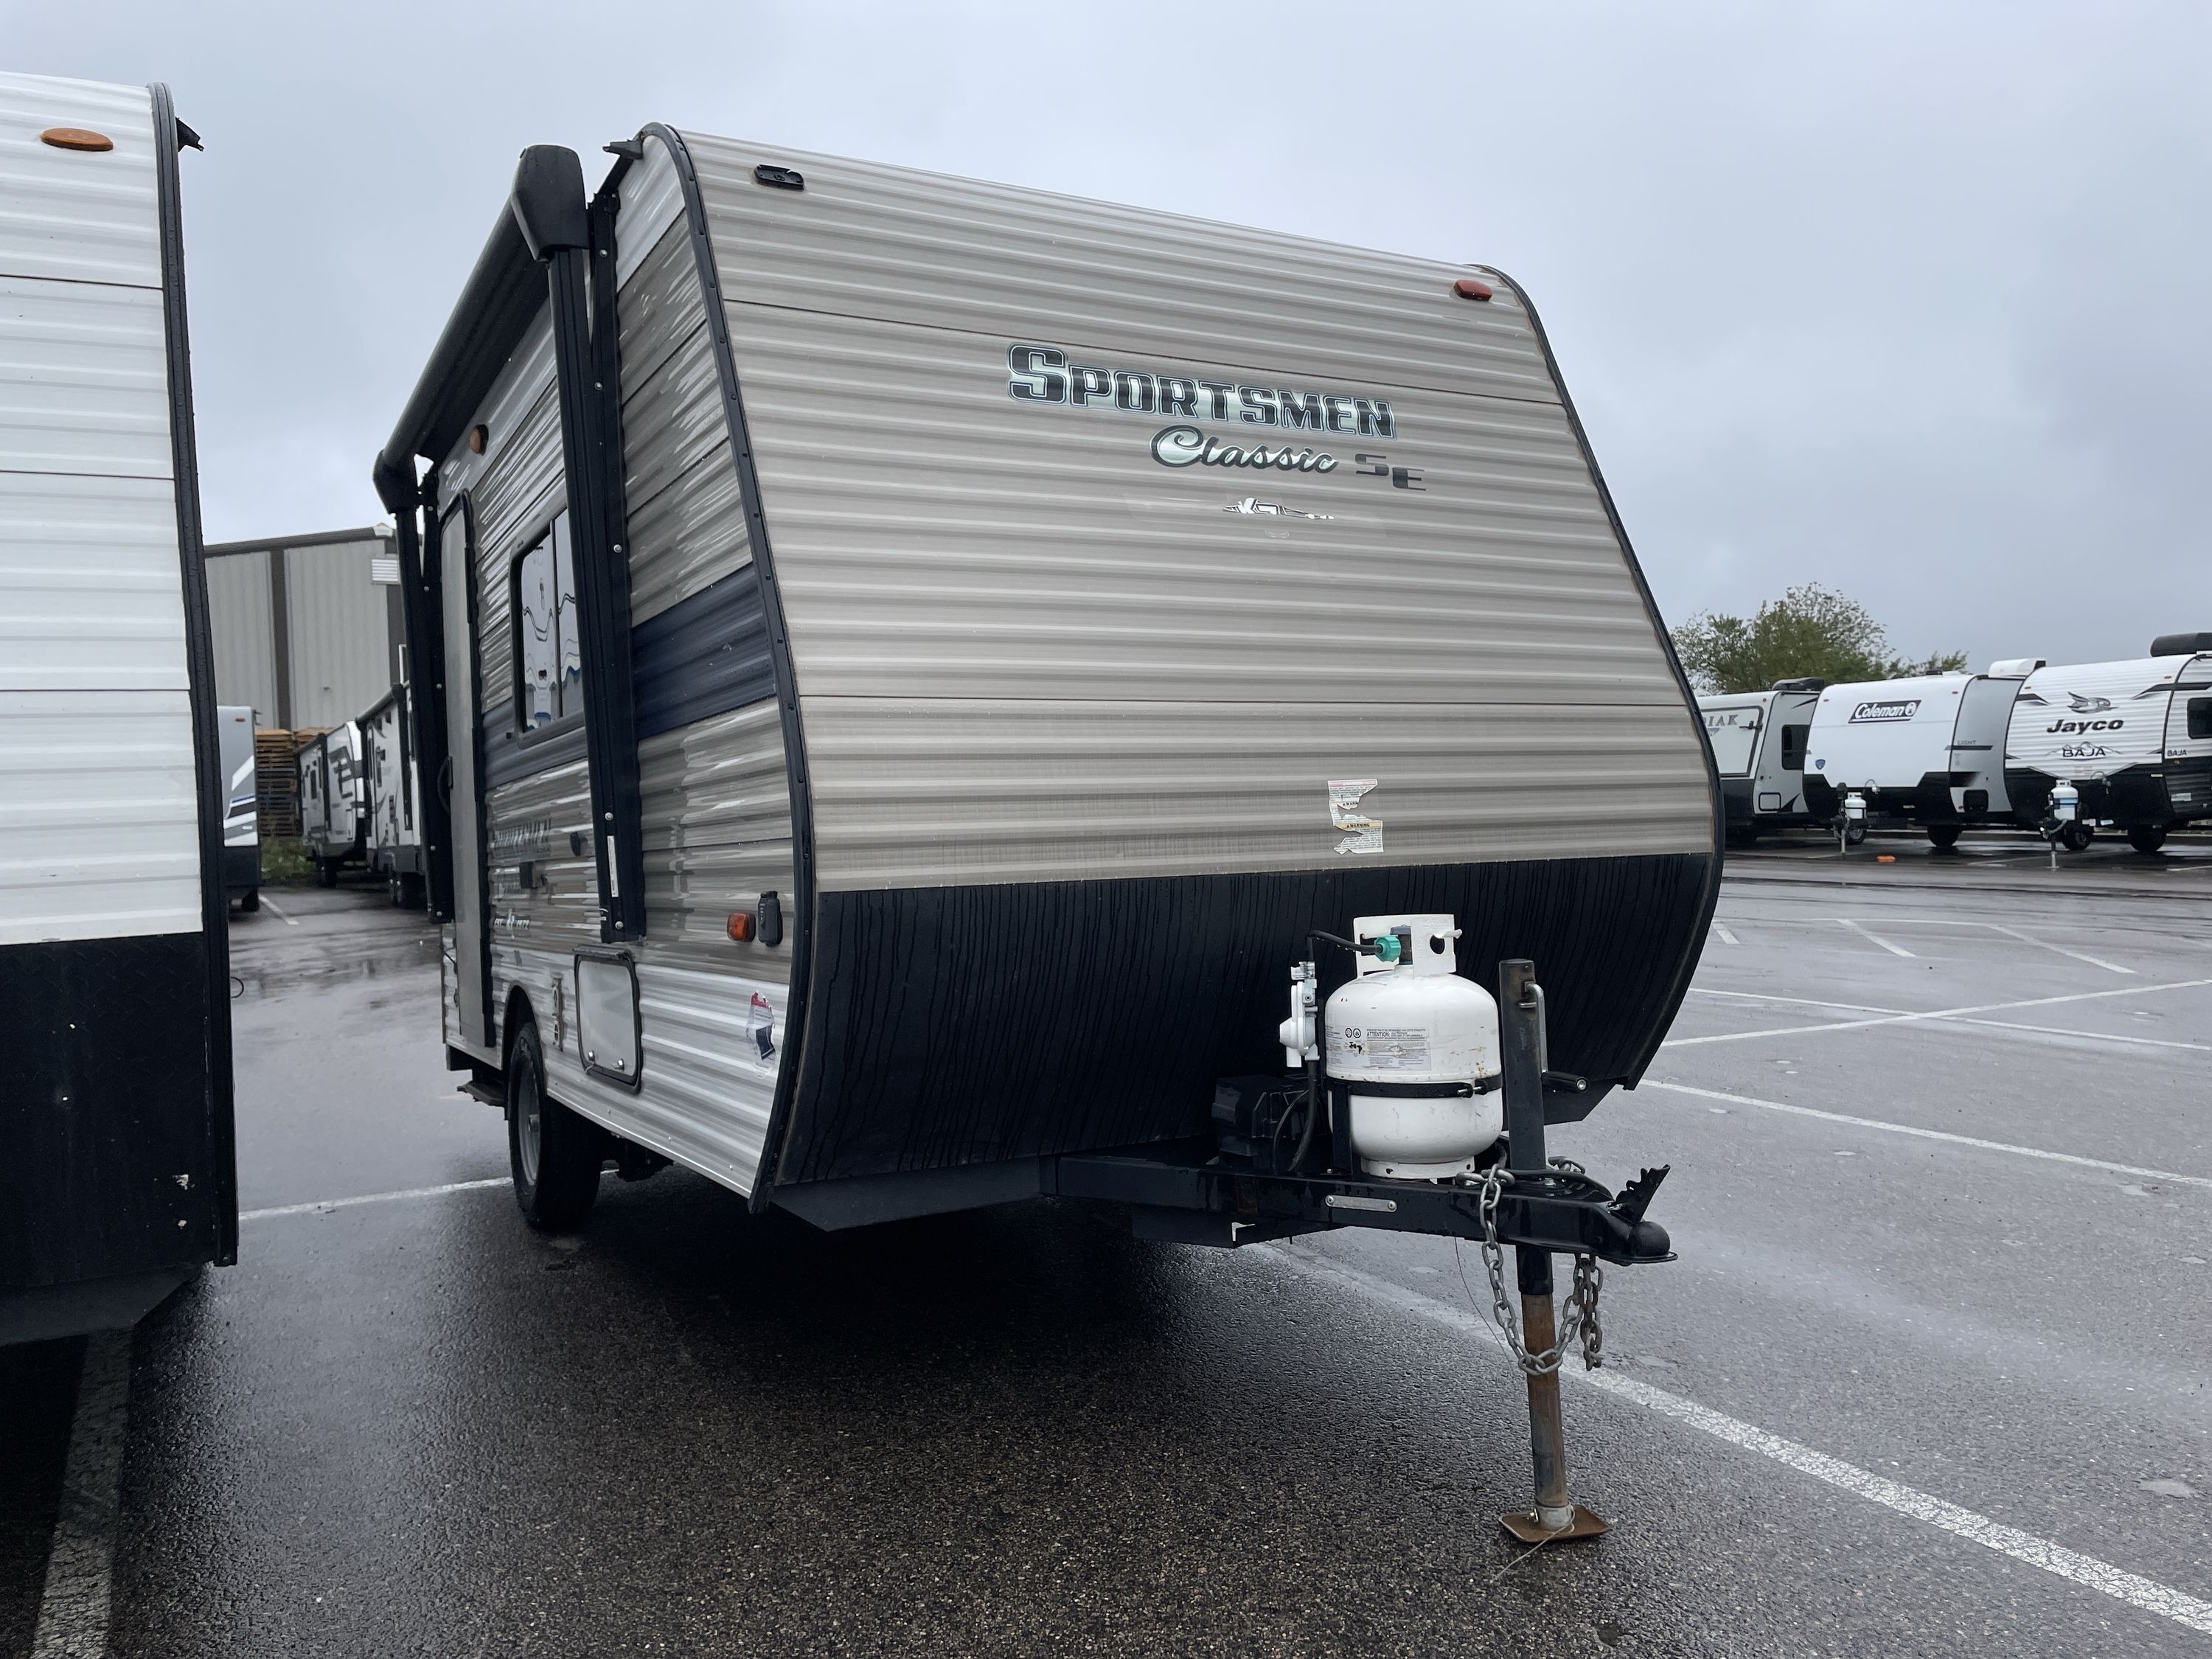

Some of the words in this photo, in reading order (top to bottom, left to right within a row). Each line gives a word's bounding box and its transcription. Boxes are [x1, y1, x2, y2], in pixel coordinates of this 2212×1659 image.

[1006, 342, 1397, 439] SPORTSMEN
[1150, 424, 1339, 473] Classic
[1354, 453, 1427, 491] SE
[1854, 703, 1905, 719] Coleman
[2046, 719, 2124, 735] Jayco
[2062, 748, 2107, 758] BAJA
